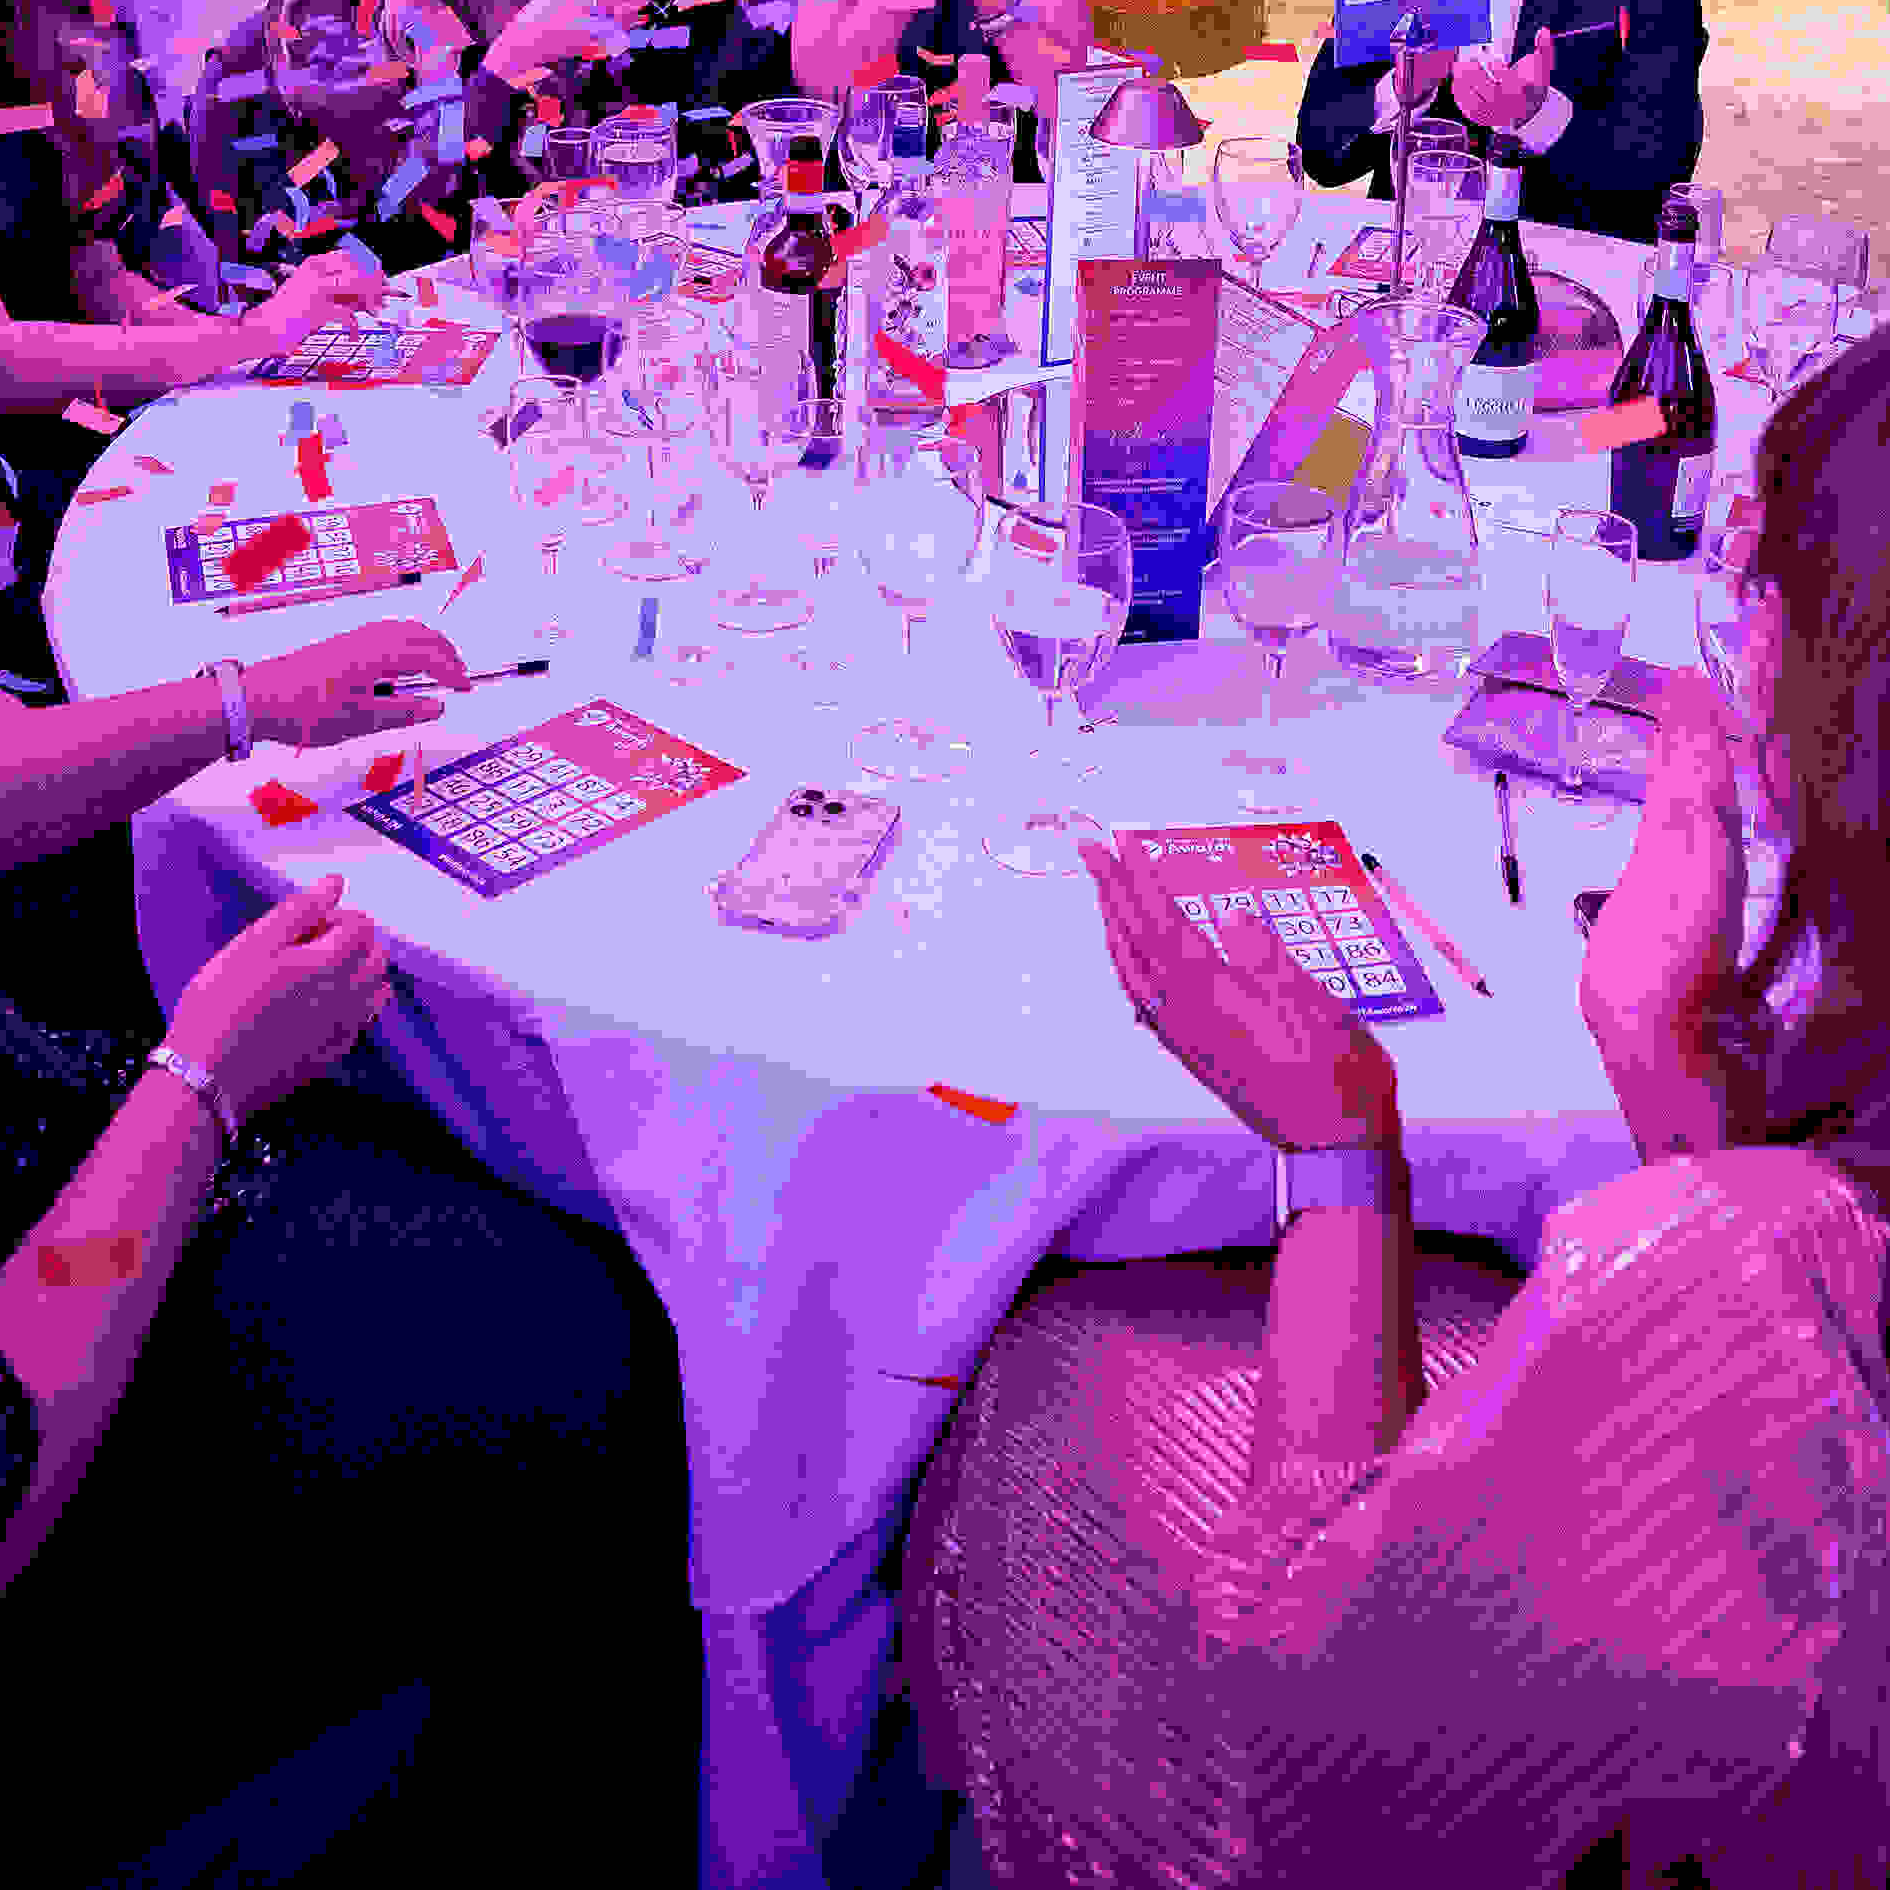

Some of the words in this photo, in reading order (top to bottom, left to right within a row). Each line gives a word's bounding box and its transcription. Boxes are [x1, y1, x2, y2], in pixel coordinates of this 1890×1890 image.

[1133, 272, 1167, 284] EVENT
[1111, 286, 1183, 297] PROGRAMME
[1322, 888, 1351, 905] 17
[1362, 970, 1398, 988] 84
